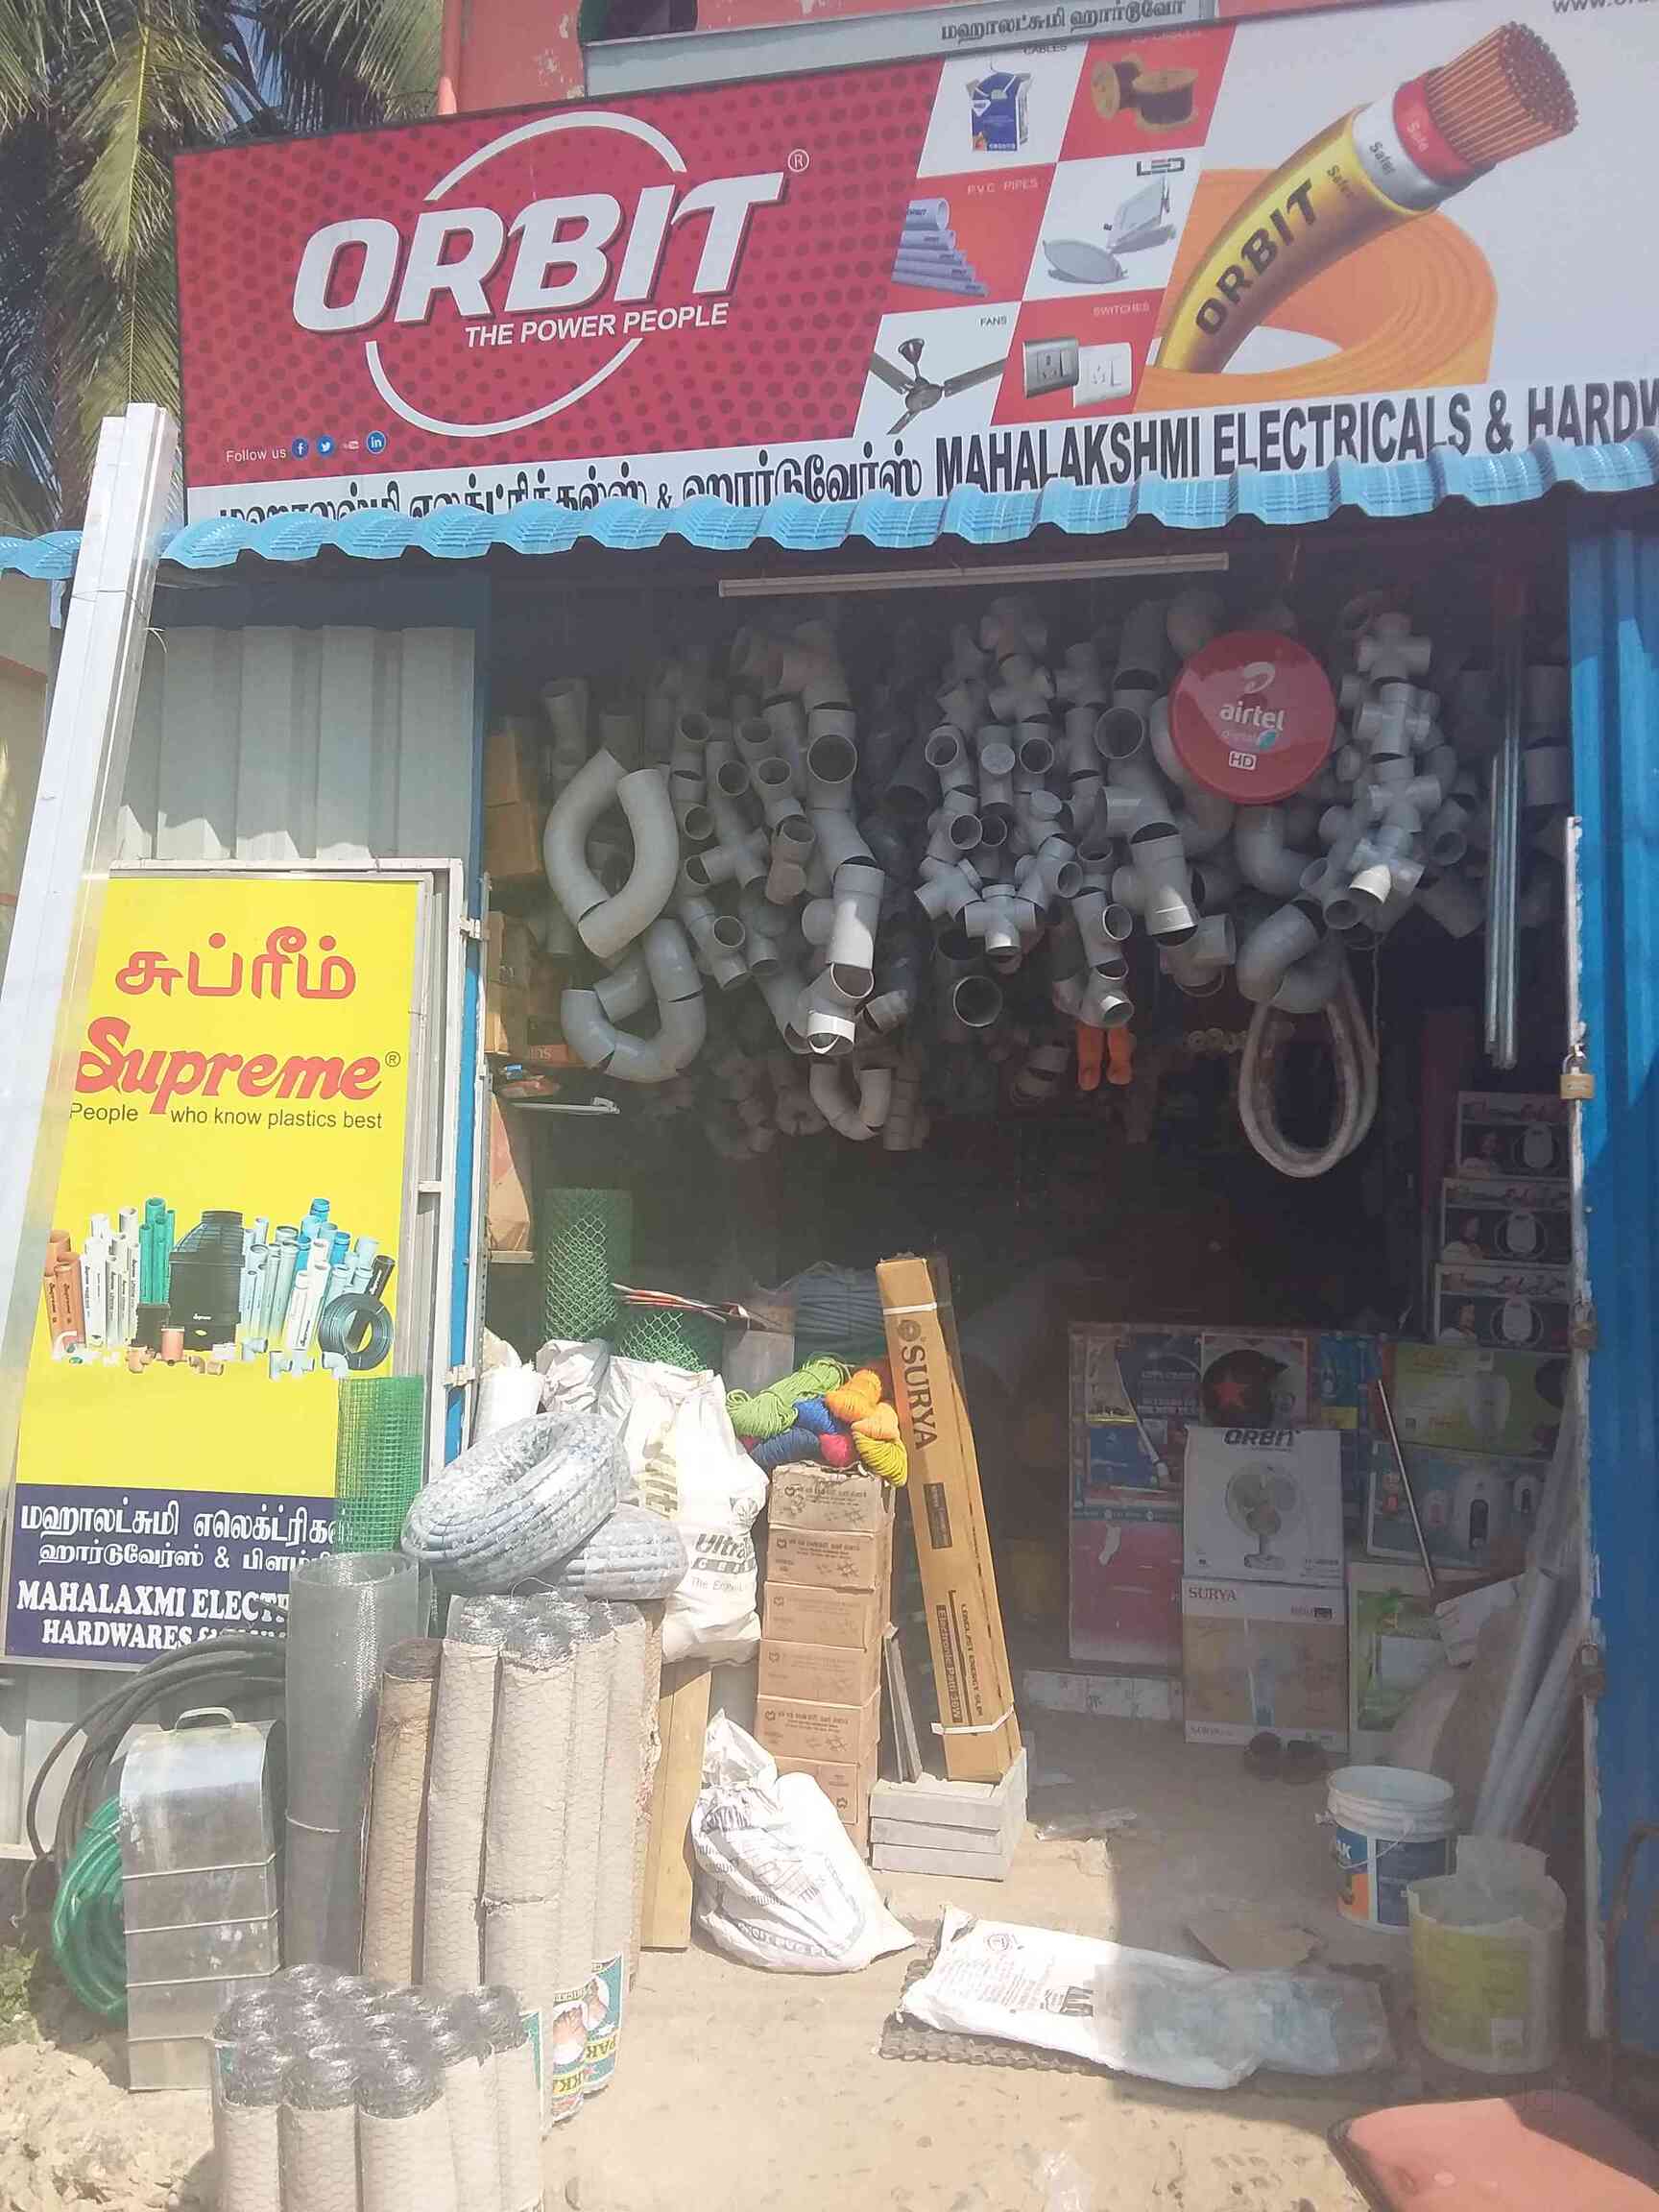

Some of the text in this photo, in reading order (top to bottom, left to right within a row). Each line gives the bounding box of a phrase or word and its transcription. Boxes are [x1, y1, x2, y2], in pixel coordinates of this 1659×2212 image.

[292, 171, 785, 333] ORBIT
[1195, 178, 1316, 335] ORBIT
[465, 303, 730, 348] THE POWER PEOPLE
[980, 316, 1007, 327] FANS
[226, 449, 267, 462] Follow
[272, 447, 286, 459] us
[935, 416, 1200, 497] MAHALAKSHMI
[1214, 392, 1472, 475] ELECTRICALS
[1485, 390, 1514, 454] &
[657, 483, 672, 509] &
[1219, 701, 1286, 732] airtel
[1231, 752, 1255, 768] HD
[115, 926, 356, 999] சுப்ரீம்
[75, 1016, 382, 1115] Supreme
[69, 1102, 383, 1130] People who know plastics best
[902, 1345, 938, 1450] SURYA
[21, 1497, 180, 1539] மஹாலட்சுமி
[38, 1539, 204, 1568] ஹார்டுவேர்ஸ்
[214, 1546, 230, 1569] &
[16, 1580, 186, 1618] MAHALAXMI
[1188, 1586, 1237, 1601] SURYA
[42, 1619, 191, 1650] HARDWARES
